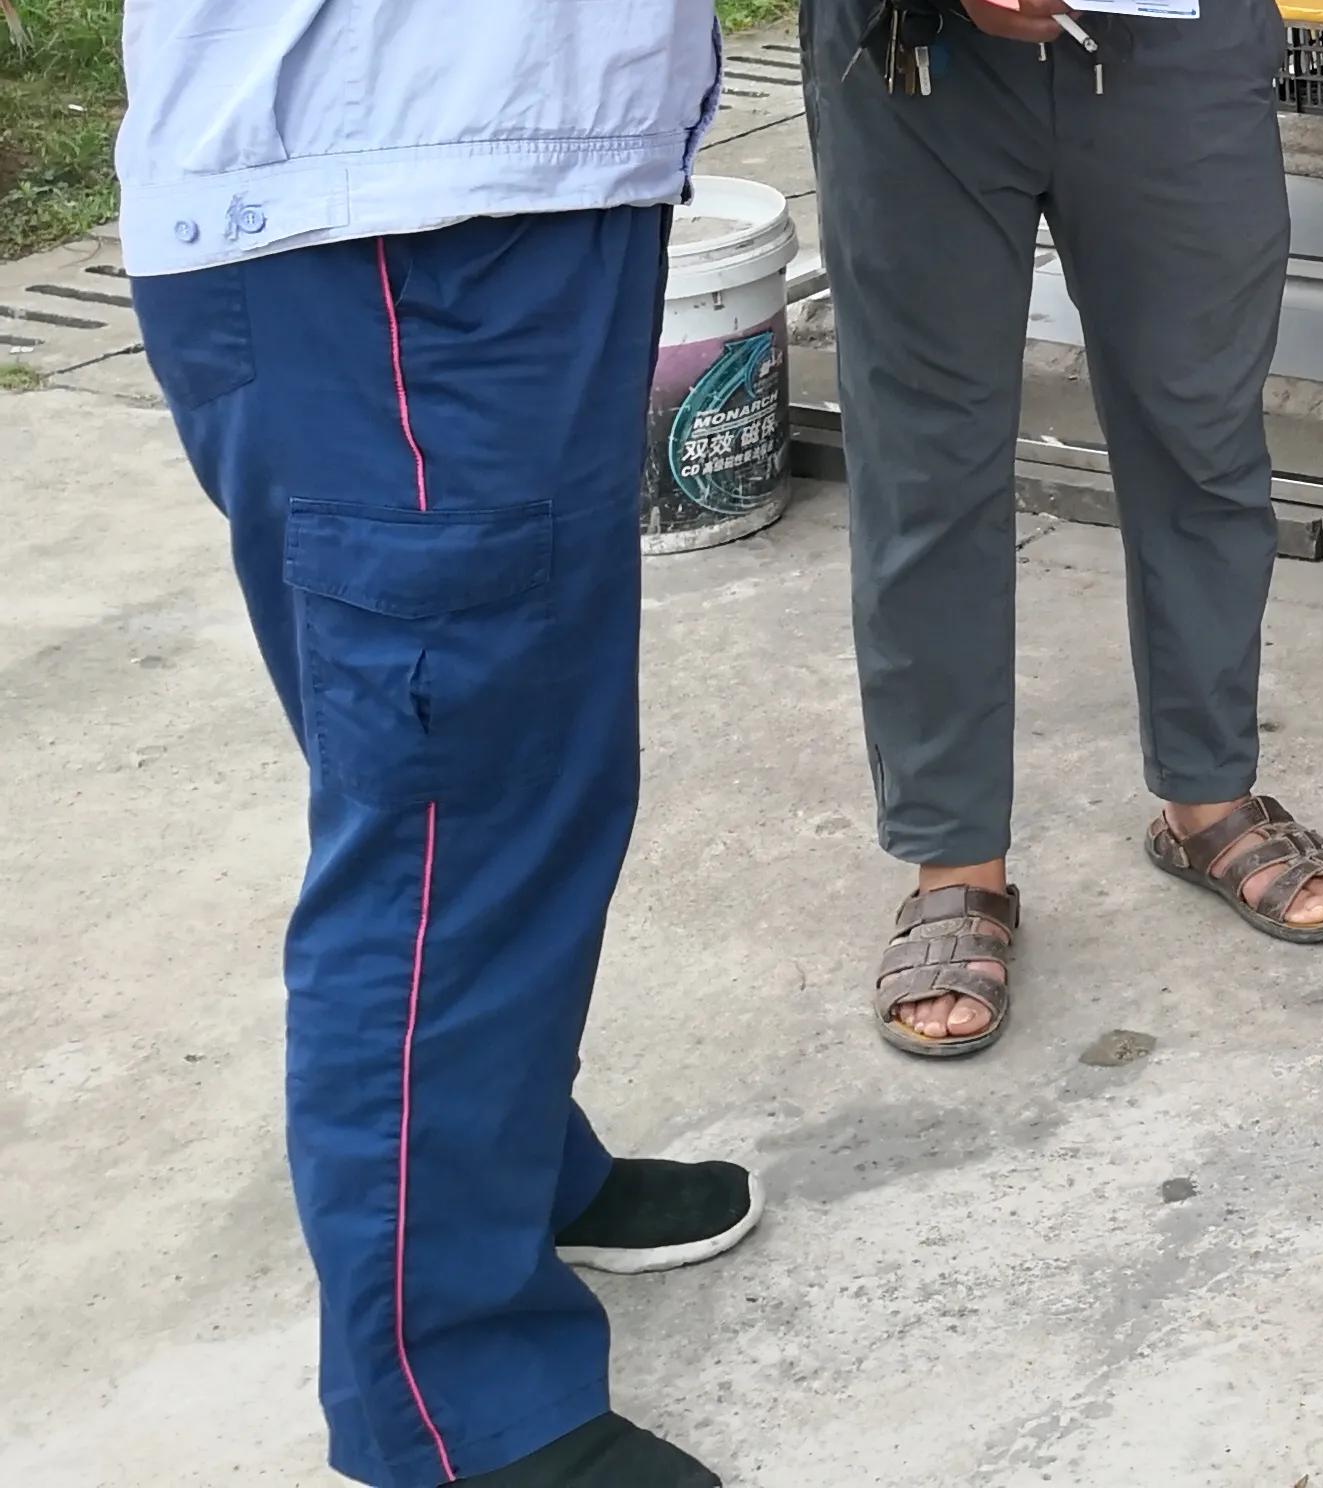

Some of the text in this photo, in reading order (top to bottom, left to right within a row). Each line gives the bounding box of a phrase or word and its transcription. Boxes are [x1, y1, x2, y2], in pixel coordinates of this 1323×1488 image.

[693, 390, 778, 429] MONARCH
[681, 431, 735, 461] 双效
[681, 465, 700, 477] CD
